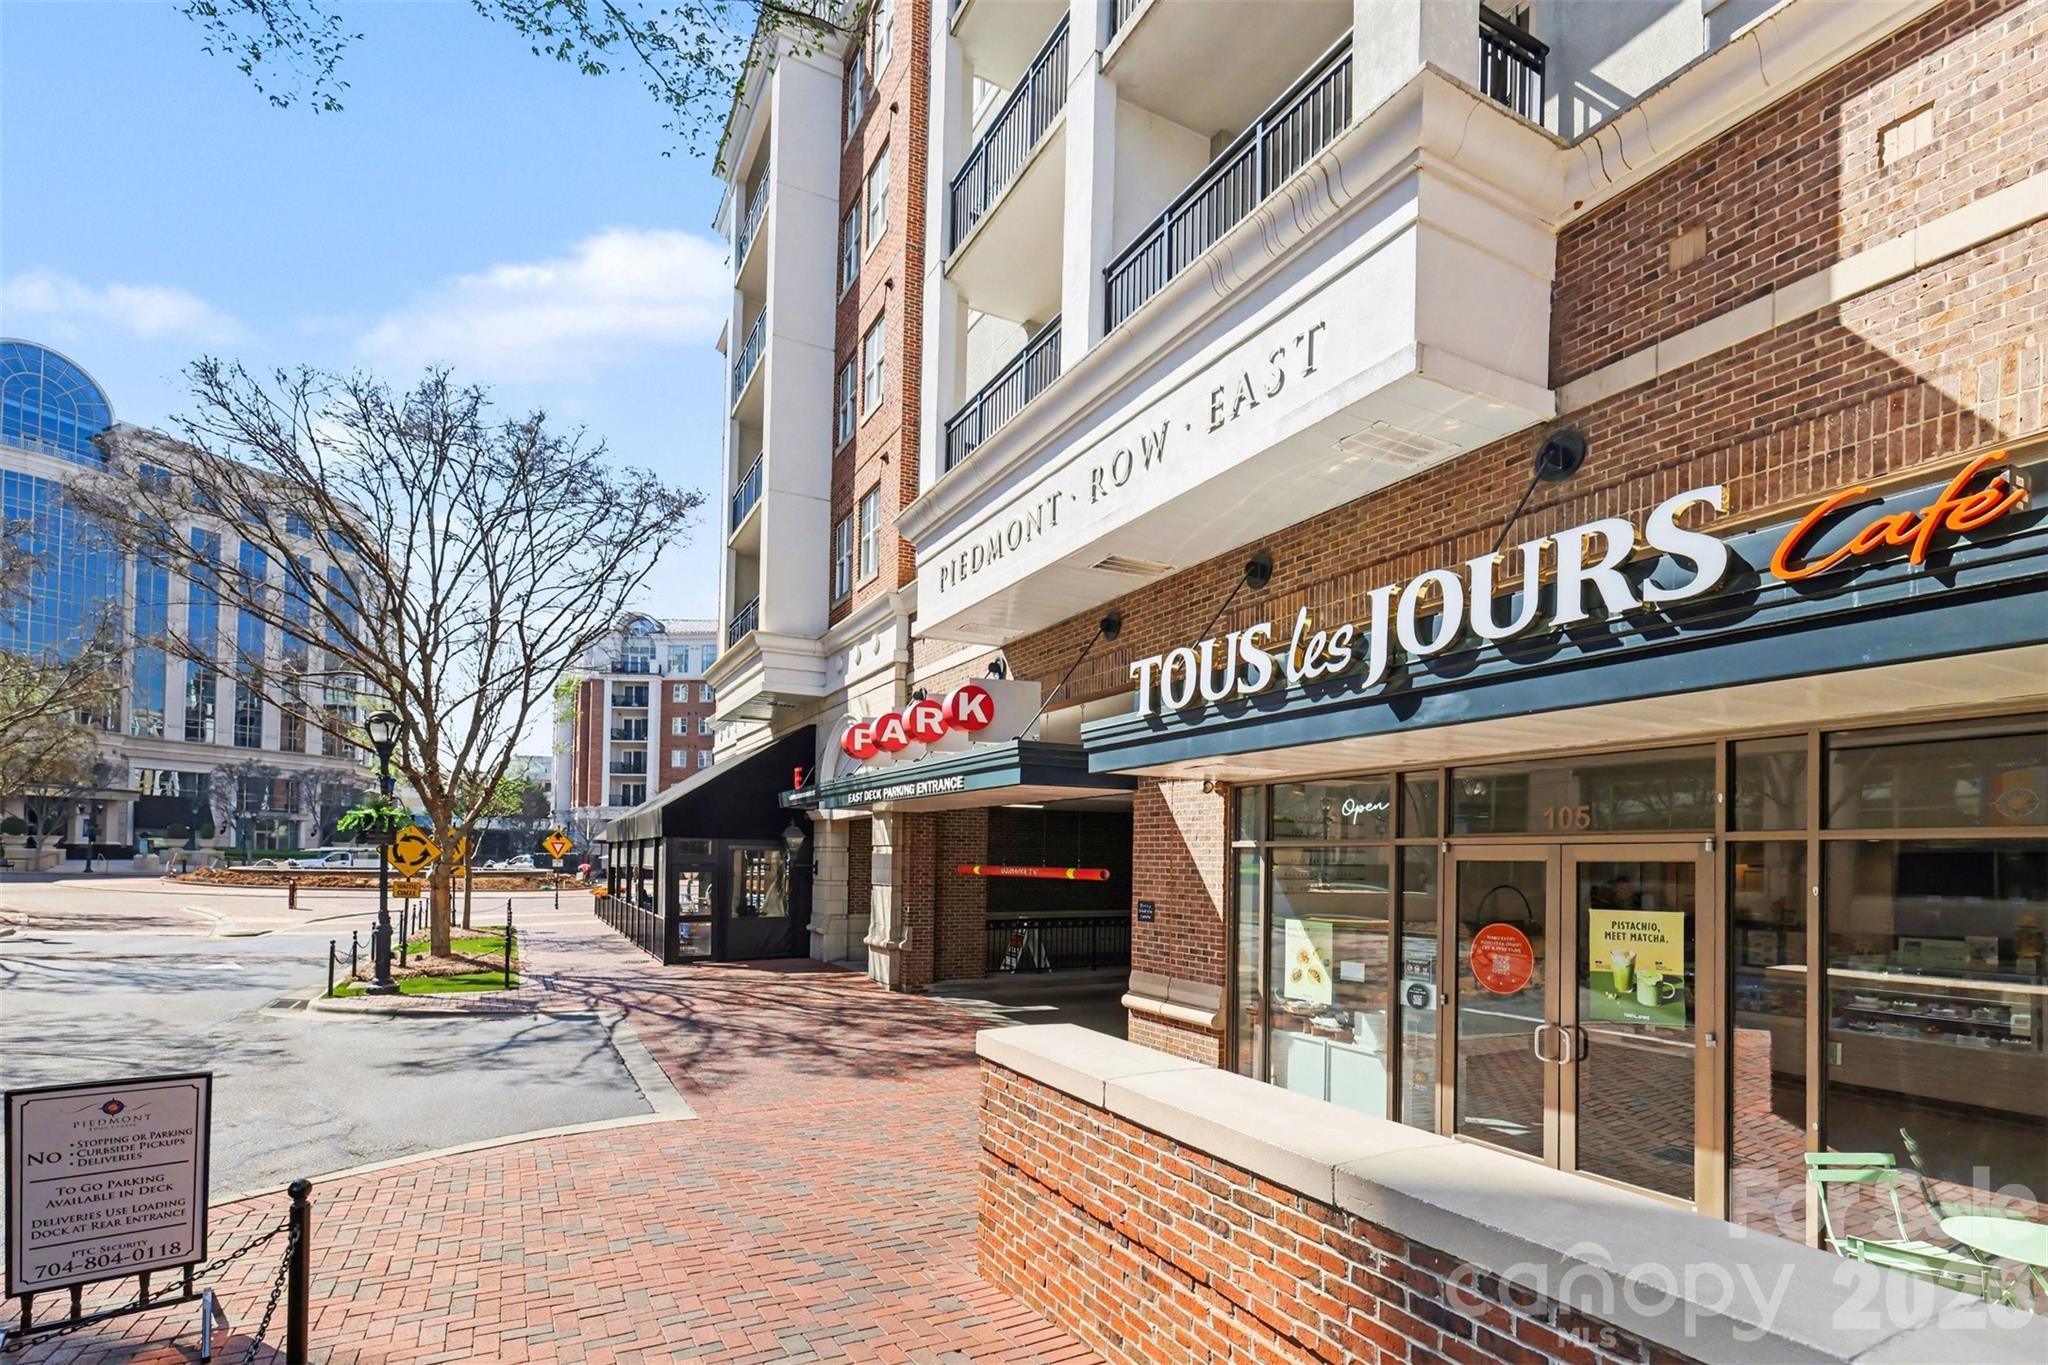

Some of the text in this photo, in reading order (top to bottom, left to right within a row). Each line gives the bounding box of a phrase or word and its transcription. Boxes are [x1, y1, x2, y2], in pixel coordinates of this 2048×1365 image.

[938, 320, 1326, 593] PIEDMONT ROW EAST
[1130, 450, 2028, 718] TOUS les JOURS Café
[854, 691, 988, 751] PARK
[848, 776, 964, 804] EAST DECK PARKING ENTRANCE
[1341, 798, 1390, 825] Open
[1544, 805, 1592, 830] 105
[1604, 931, 1669, 944] MEET MATCHA.
[1611, 920, 1661, 933] PISTACHIO,
[73, 1114, 152, 1129] PIEDMONT
[77, 1128, 193, 1149] STOPPING OR PARKING
[77, 1138, 185, 1158] CURBSIDE PICKUPS
[27, 1151, 62, 1166] NO
[77, 1152, 143, 1167] DELIVERIES
[46, 1184, 174, 1209] AVAILABLE IN DECK
[55, 1174, 165, 1196] TO GO PARKING
[31, 1208, 187, 1240] DOCK AT REAR ENTRANCE
[32, 1198, 186, 1229] DELIVERIES USE LOADING
[35, 1241, 181, 1279] 704-804-0118
[72, 1240, 148, 1258] PTC SECURITY
